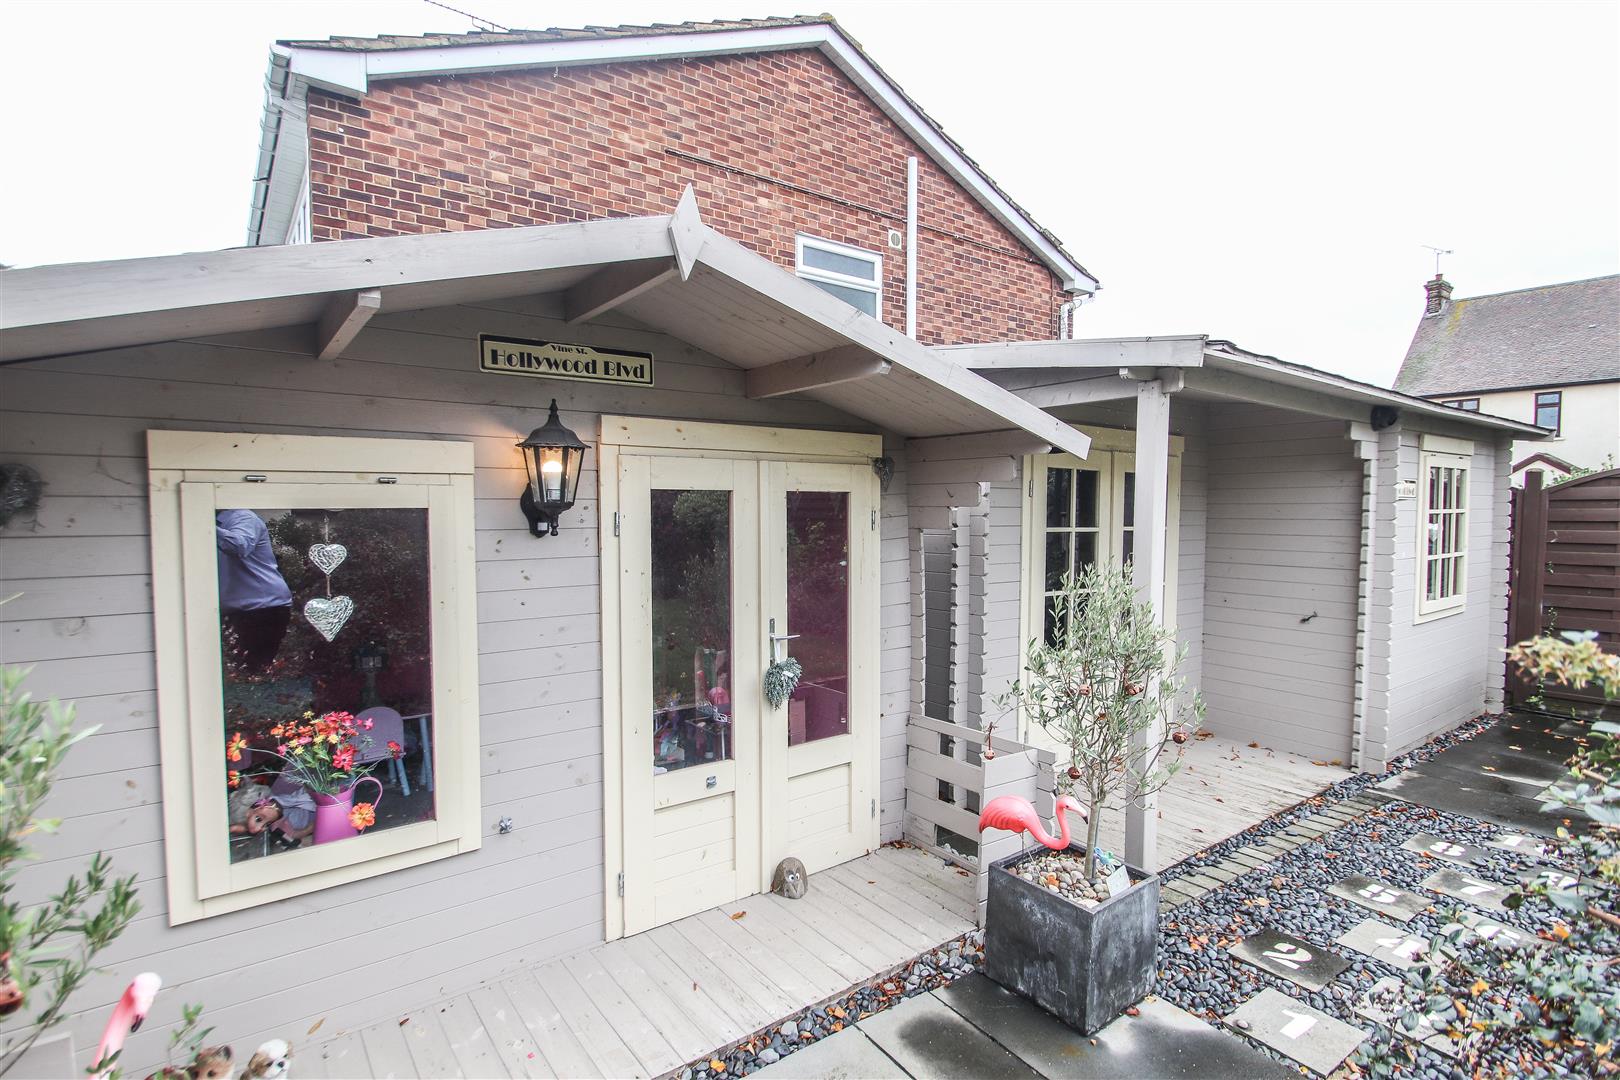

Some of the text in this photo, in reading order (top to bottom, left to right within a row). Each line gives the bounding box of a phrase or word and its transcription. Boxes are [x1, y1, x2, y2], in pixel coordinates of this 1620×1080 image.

[550, 344, 588, 355] Vine St.
[490, 348, 645, 379] Hollywood Blvd
[1429, 841, 1466, 857] 8
[1358, 883, 1401, 904] 5
[1460, 877, 1497, 896] 7
[1262, 942, 1313, 970] 2
[1279, 1008, 1319, 1040] 1
